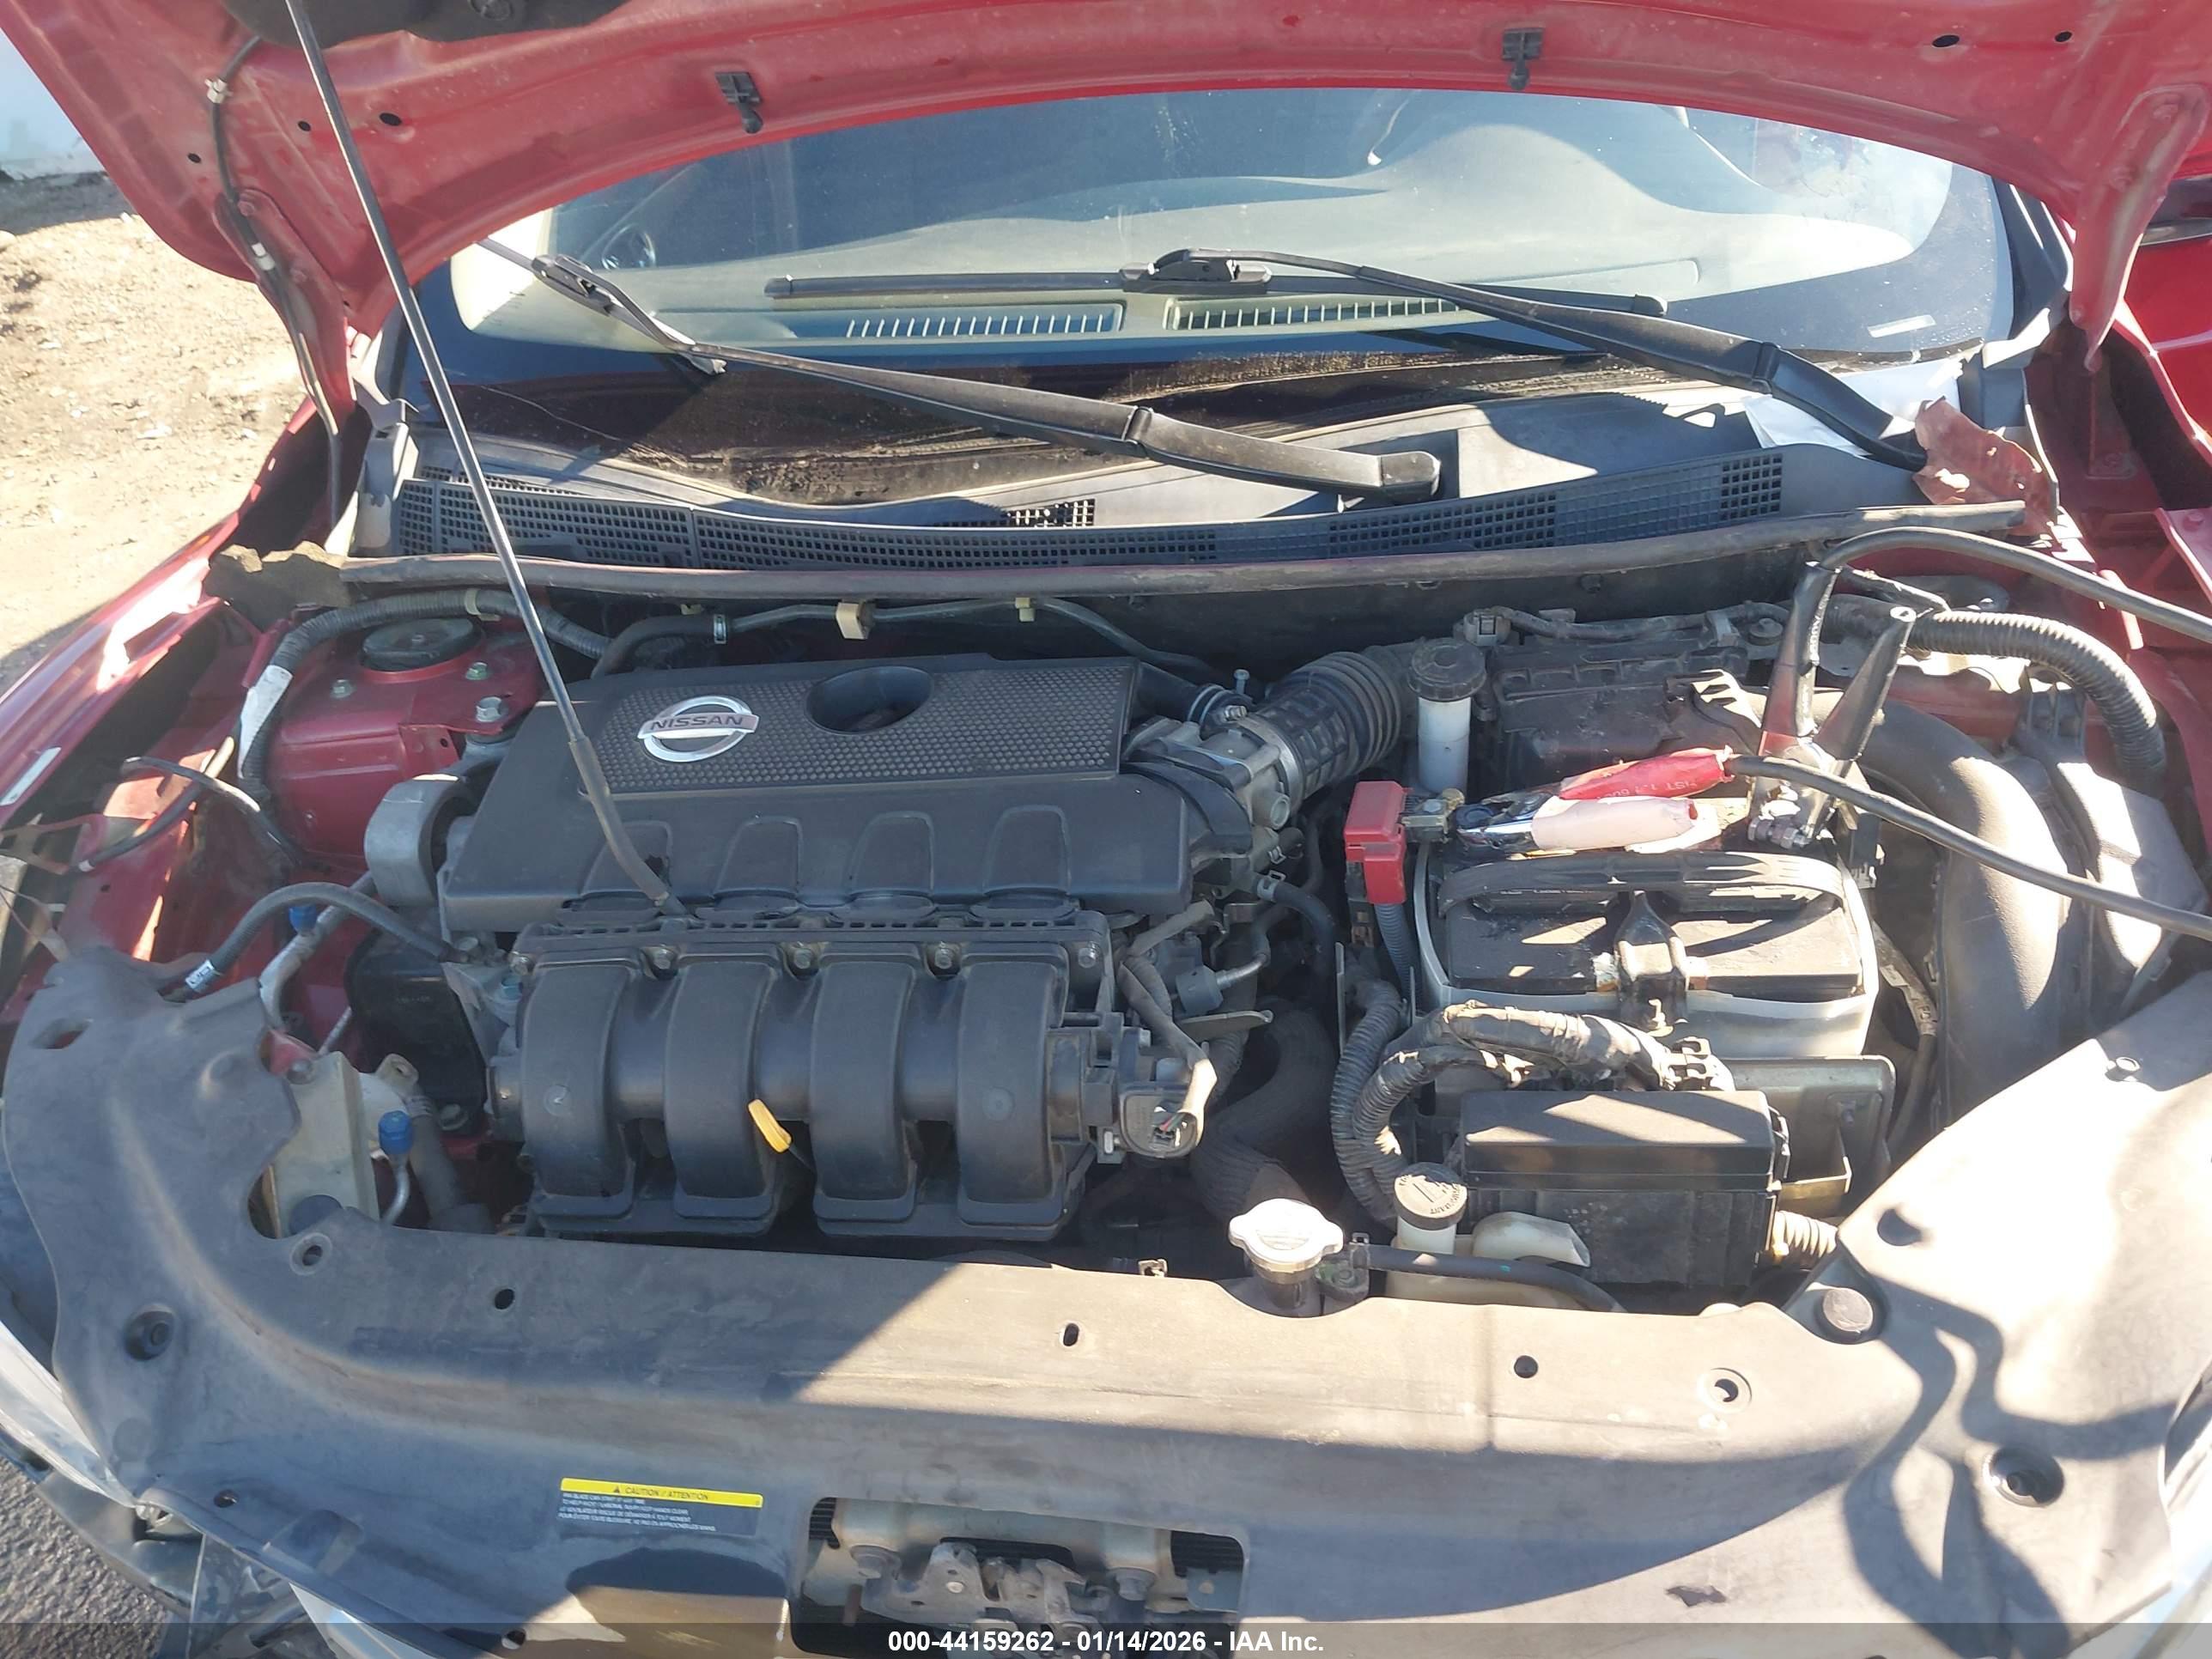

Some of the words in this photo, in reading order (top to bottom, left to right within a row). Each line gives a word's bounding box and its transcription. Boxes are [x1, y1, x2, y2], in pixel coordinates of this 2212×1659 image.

[651, 715, 744, 730] NISSAN
[624, 1486, 659, 1497] CAUTION
[668, 1490, 709, 1501] ATTENTION
